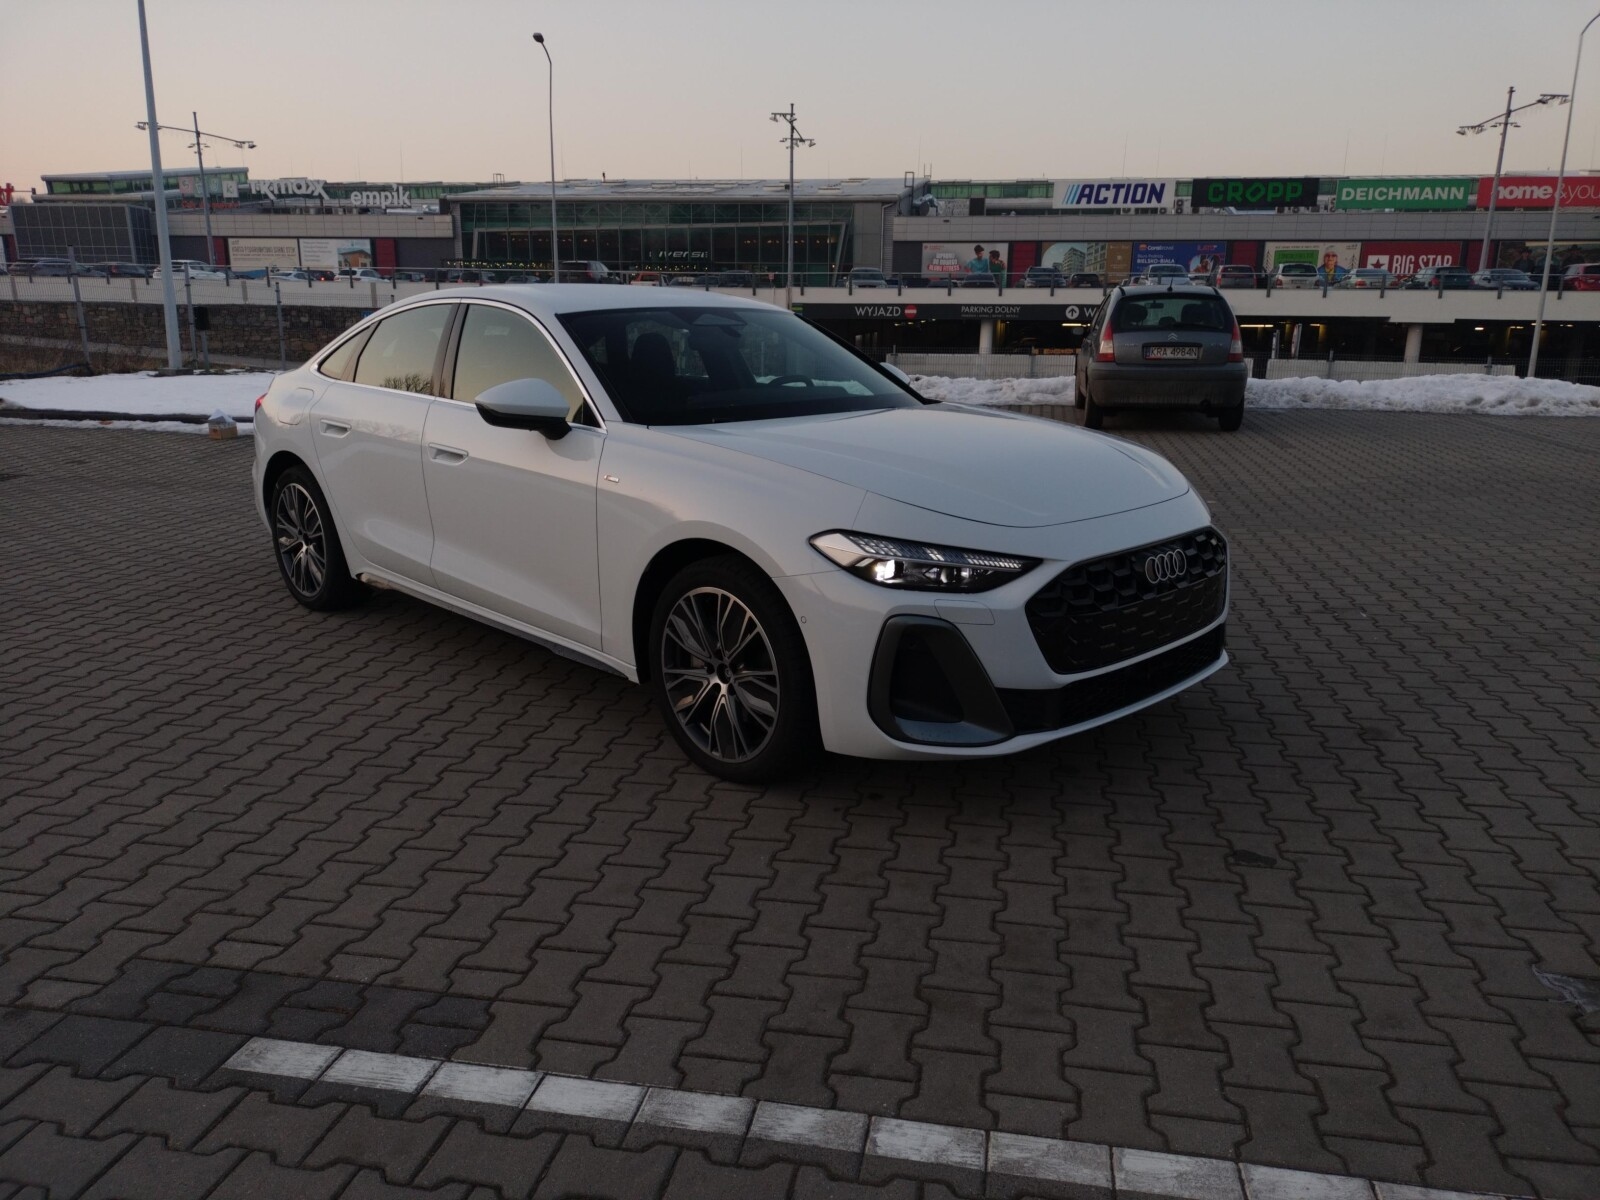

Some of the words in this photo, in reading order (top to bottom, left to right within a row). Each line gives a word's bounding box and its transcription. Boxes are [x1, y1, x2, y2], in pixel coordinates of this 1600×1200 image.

[351, 184, 411, 210] empik
[1076, 182, 1166, 205] ACTION
[1208, 181, 1303, 203] CROPP
[1341, 186, 1466, 201] DEICHMANN
[1392, 254, 1416, 275] BIG
[854, 305, 902, 318] WYJAZD
[960, 305, 993, 314] PARKING
[994, 305, 1021, 314] DOLNY
[1083, 306, 1098, 319] W
[1151, 347, 1169, 357] KRA
[1170, 347, 1198, 357] 4984N
